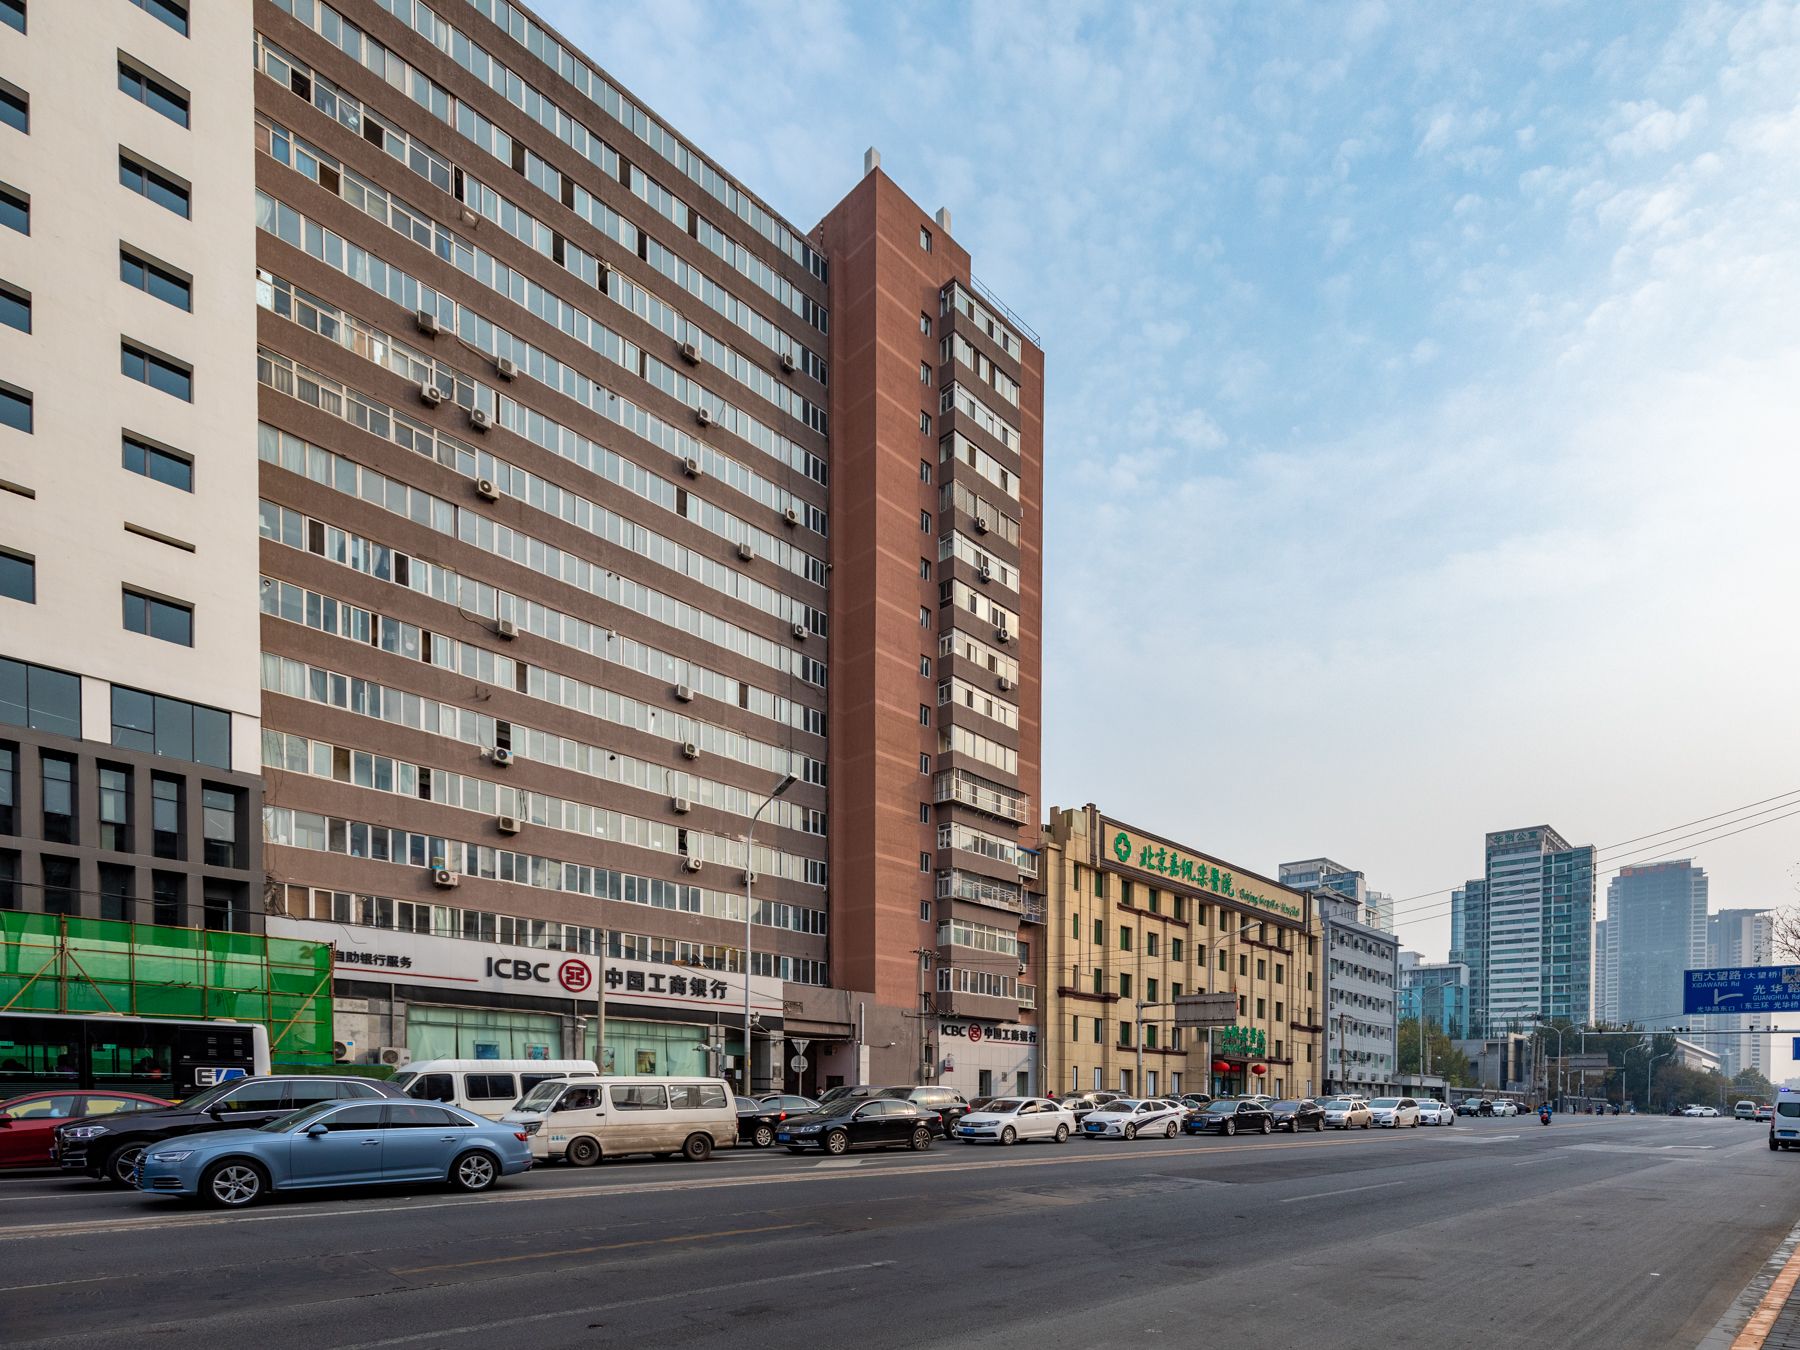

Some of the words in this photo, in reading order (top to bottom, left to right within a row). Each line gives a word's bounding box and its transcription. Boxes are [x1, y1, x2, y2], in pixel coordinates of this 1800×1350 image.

[335, 950, 412, 969] 自助银行服务
[486, 956, 550, 983] ICBC
[1692, 971, 1741, 981] 西大望路
[604, 967, 728, 1000] 中国工商银行
[941, 1024, 966, 1037] ICBC
[984, 1026, 1037, 1043] 中国工商银行
